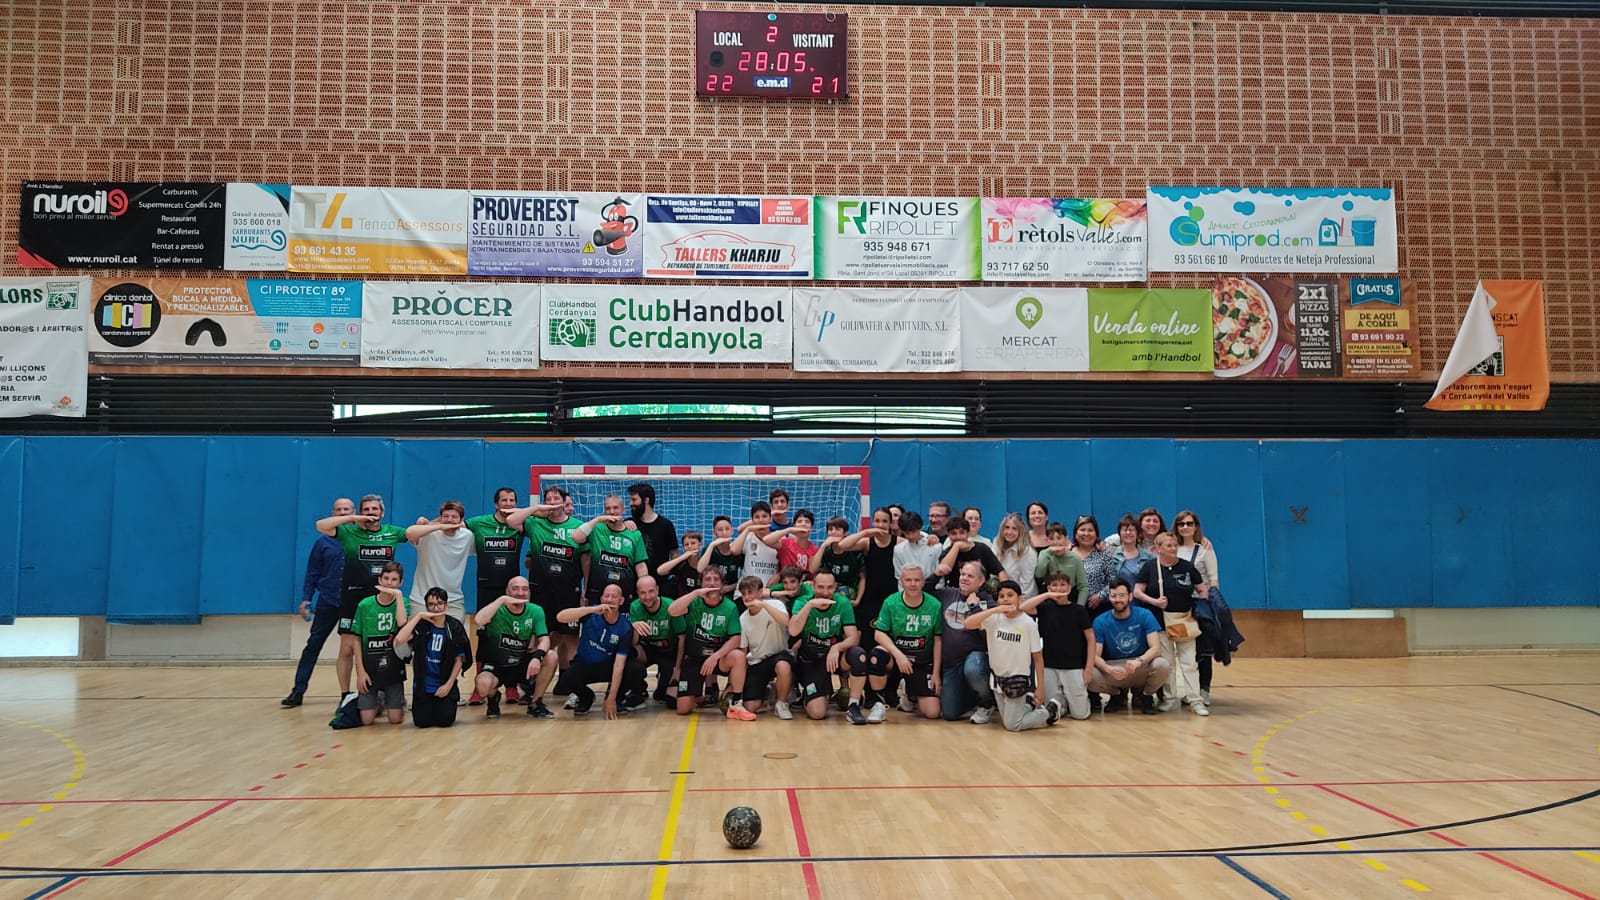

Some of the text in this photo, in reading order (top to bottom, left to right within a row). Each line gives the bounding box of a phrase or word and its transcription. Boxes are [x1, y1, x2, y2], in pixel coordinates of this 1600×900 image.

[714, 32, 743, 46] LOCAL
[766, 26, 778, 42] 2
[793, 34, 834, 48] VISITANT
[706, 75, 733, 91] 22
[756, 78, 788, 88] e.m.d
[812, 77, 838, 94] 21
[34, 190, 107, 214] nuroil
[138, 201, 184, 209] Supermercats
[473, 197, 579, 222] PROVEREST
[870, 202, 958, 218] FINQUES
[472, 222, 580, 237] SEGURIDAD S.L.
[870, 221, 958, 235] RIPOLLET
[864, 242, 930, 251] 935 948 671
[68, 255, 137, 263] www.nuroil.cat
[675, 248, 781, 262] TALLERS KHARJU
[1174, 254, 1375, 266] 93 561 66 10 Productes de Neteja Professional
[260, 286, 346, 295] CI PROTECT 89
[1299, 287, 1328, 300] 2x1
[609, 298, 784, 322] ClubHandbol
[840, 321, 883, 331] GOLDWATER
[885, 321, 890, 331] &
[893, 321, 932, 332] PARTNERS,
[1094, 311, 1200, 336] Venda online
[609, 325, 762, 354] Cerdanyola
[1002, 336, 1057, 346] MERCAT
[975, 348, 1084, 360] SERRAPERERA
[610, 536, 621, 550] 56
[544, 546, 566, 555] nuroil
[378, 613, 392, 630] 23
[513, 621, 520, 634] 6
[816, 617, 830, 633] 40
[906, 614, 919, 632] 24
[431, 634, 443, 651] 10
[996, 630, 1022, 643] PUMA
